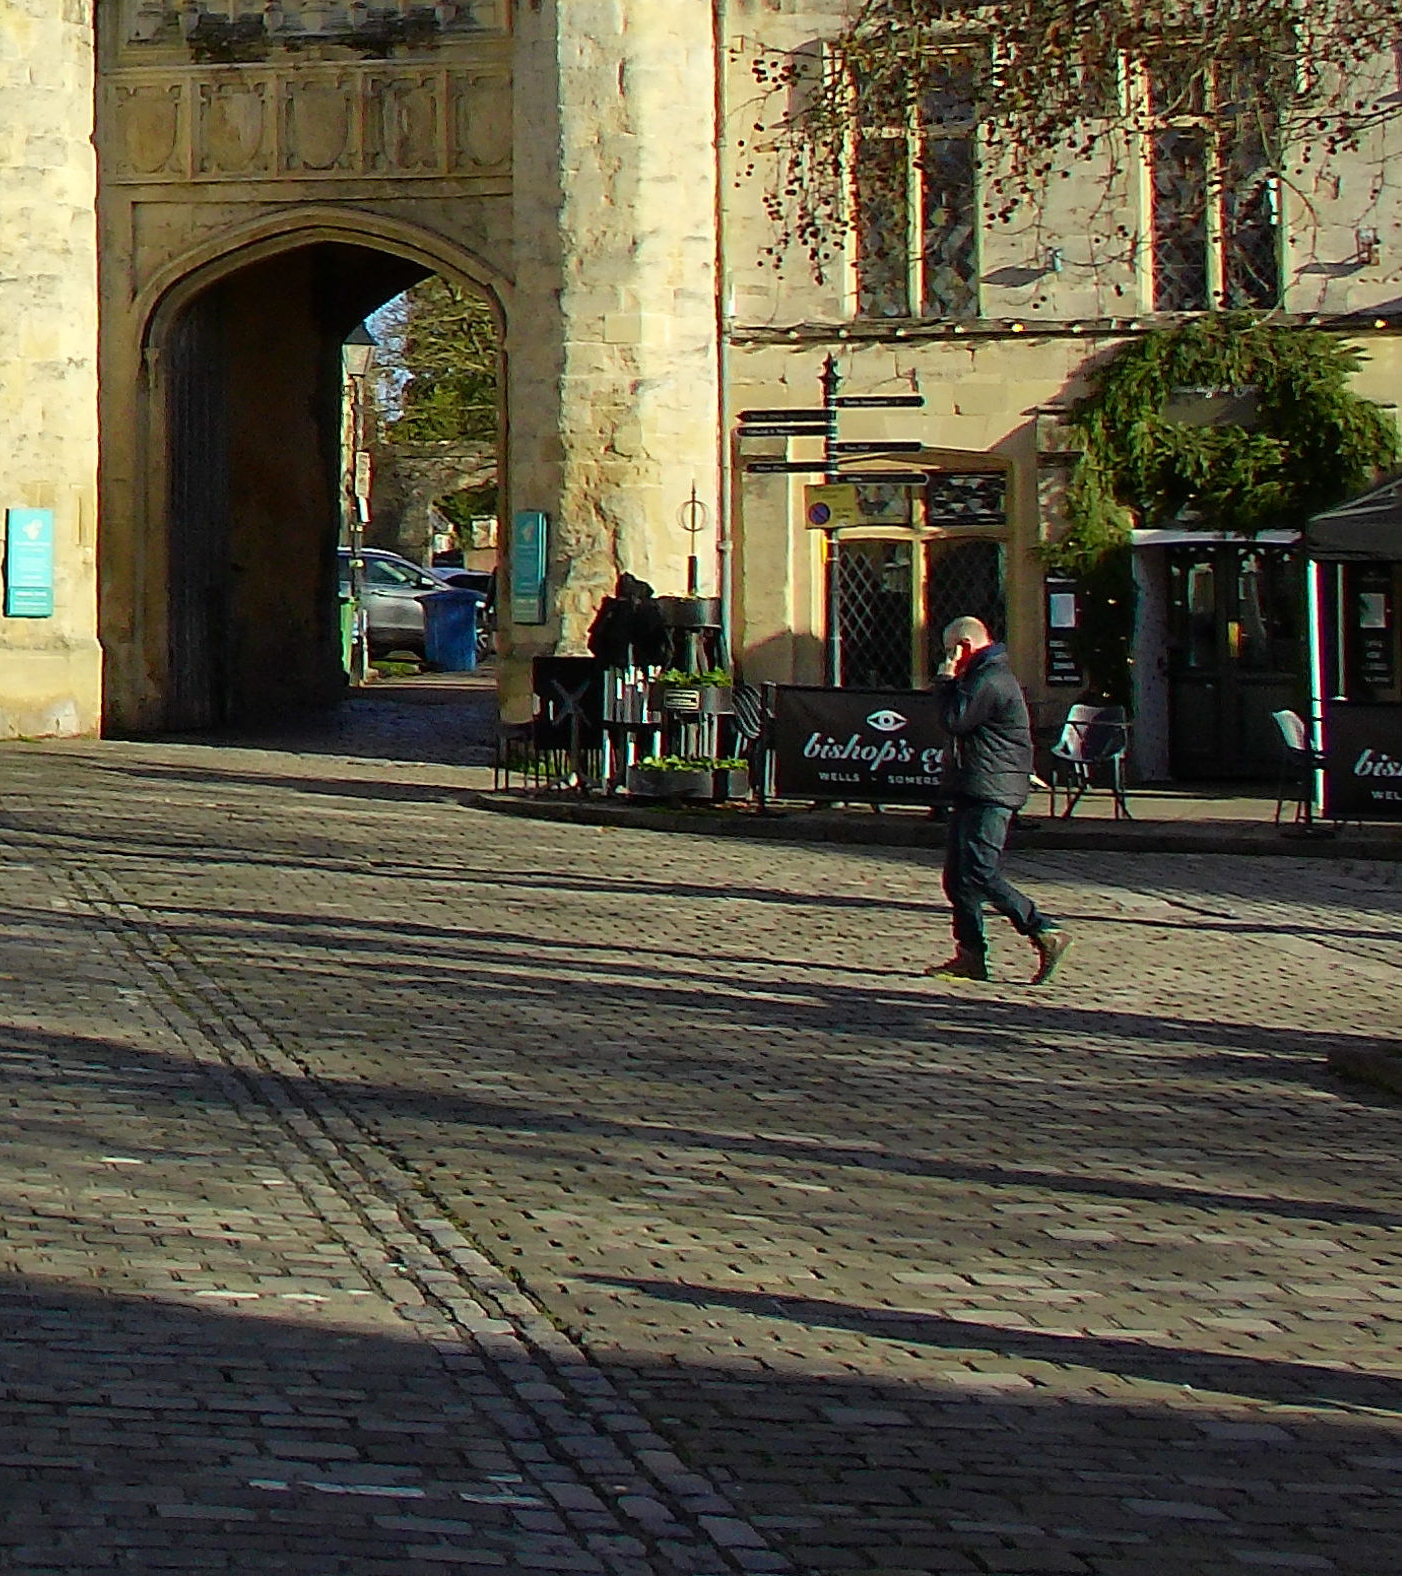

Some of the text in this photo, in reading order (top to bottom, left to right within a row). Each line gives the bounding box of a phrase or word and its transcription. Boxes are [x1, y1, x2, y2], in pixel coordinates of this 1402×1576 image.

[803, 732, 916, 772] bishop's
[1354, 748, 1402, 776] bis
[818, 771, 861, 782] WELLS
[887, 775, 942, 786] SOMERS
[1371, 790, 1402, 801] WEL
